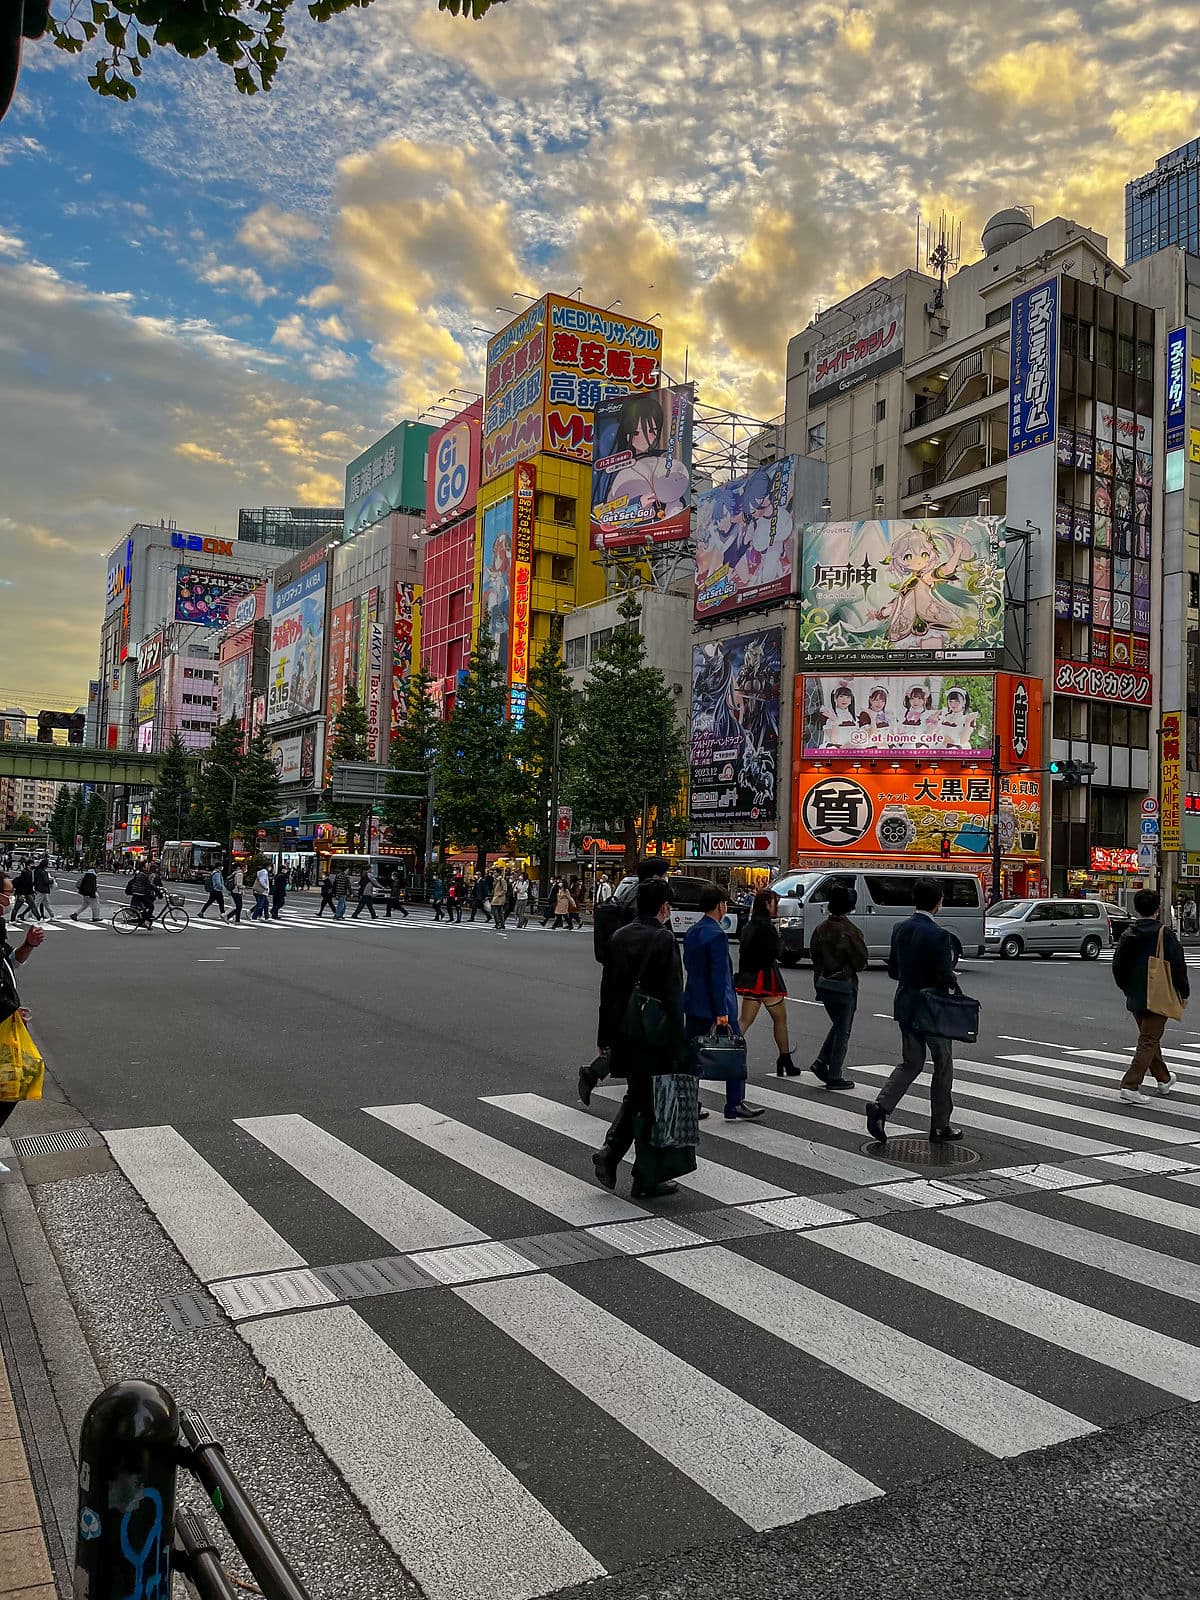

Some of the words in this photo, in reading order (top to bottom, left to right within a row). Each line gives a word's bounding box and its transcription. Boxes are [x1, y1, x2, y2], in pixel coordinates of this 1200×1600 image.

[552, 305, 659, 349] MEDIAリサイクル
[552, 332, 657, 387] 激安販売
[1076, 451, 1092, 470] 7F
[1074, 525, 1091, 543] 6F
[810, 552, 878, 602] 原神
[1073, 602, 1090, 619] 5F
[861, 652, 885, 660] Windows
[1056, 664, 1150, 702] メイドカジノ
[368, 673, 381, 725] Tax-free
[871, 733, 885, 743] at
[886, 732, 916, 743] home
[920, 732, 944, 743] cafe
[914, 777, 991, 803] 大黒屋
[1172, 765, 1180, 790] TAX
[878, 792, 909, 801] チケット
[811, 788, 865, 838] 質
[1172, 794, 1180, 827] FREE
[712, 838, 741, 849] COMIC
[742, 838, 756, 849] ZIN
